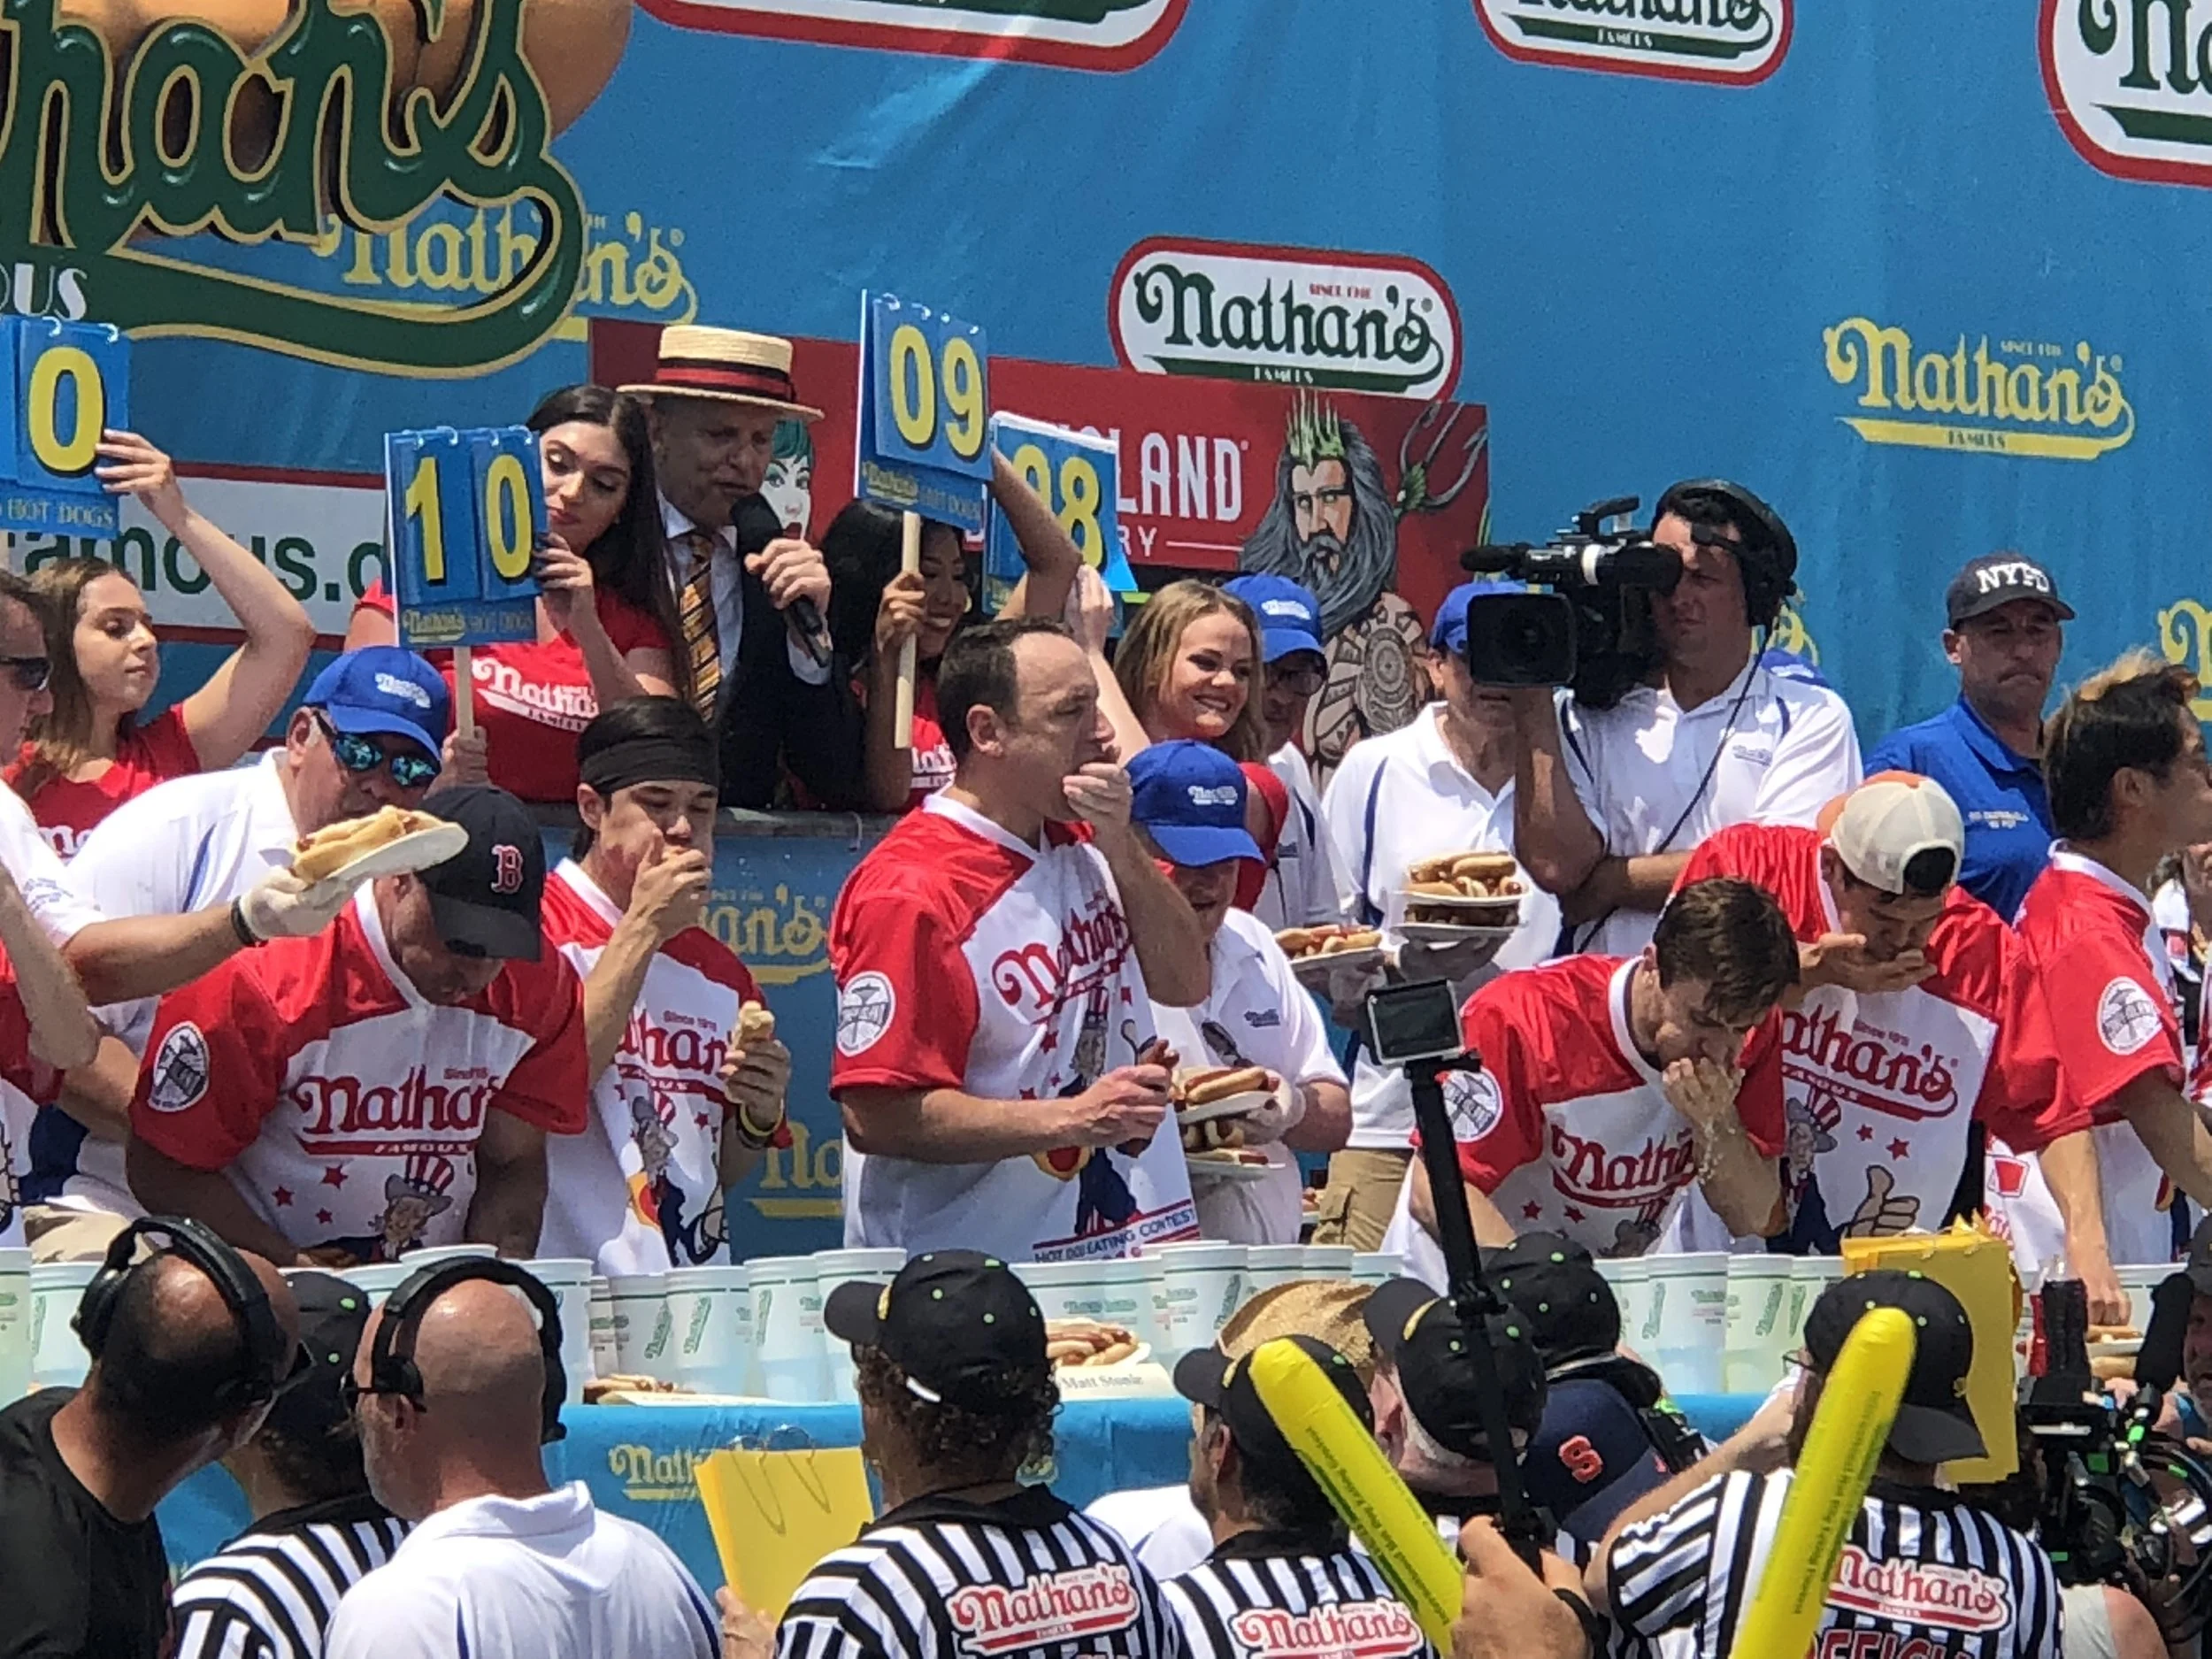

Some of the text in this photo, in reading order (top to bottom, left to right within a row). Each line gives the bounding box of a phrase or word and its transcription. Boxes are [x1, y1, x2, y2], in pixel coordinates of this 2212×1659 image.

[311, 204, 684, 310] Nathn's
[1133, 264, 1431, 364] Nathan's
[890, 325, 983, 457] 09
[1823, 317, 2123, 427] Nathan's
[405, 454, 532, 581] 10
[1975, 562, 2050, 594] NYPD
[491, 844, 524, 894] B
[697, 883, 822, 956] an's
[1087, 1229, 1136, 1256] EATING
[1061, 1374, 1098, 1389] Matt
[1559, 1434, 1603, 1485] S
[952, 1566, 1131, 1634] Nathan's
[1839, 1546, 1998, 1614] Nathan's
[1239, 1601, 1412, 1649] Nathan's
